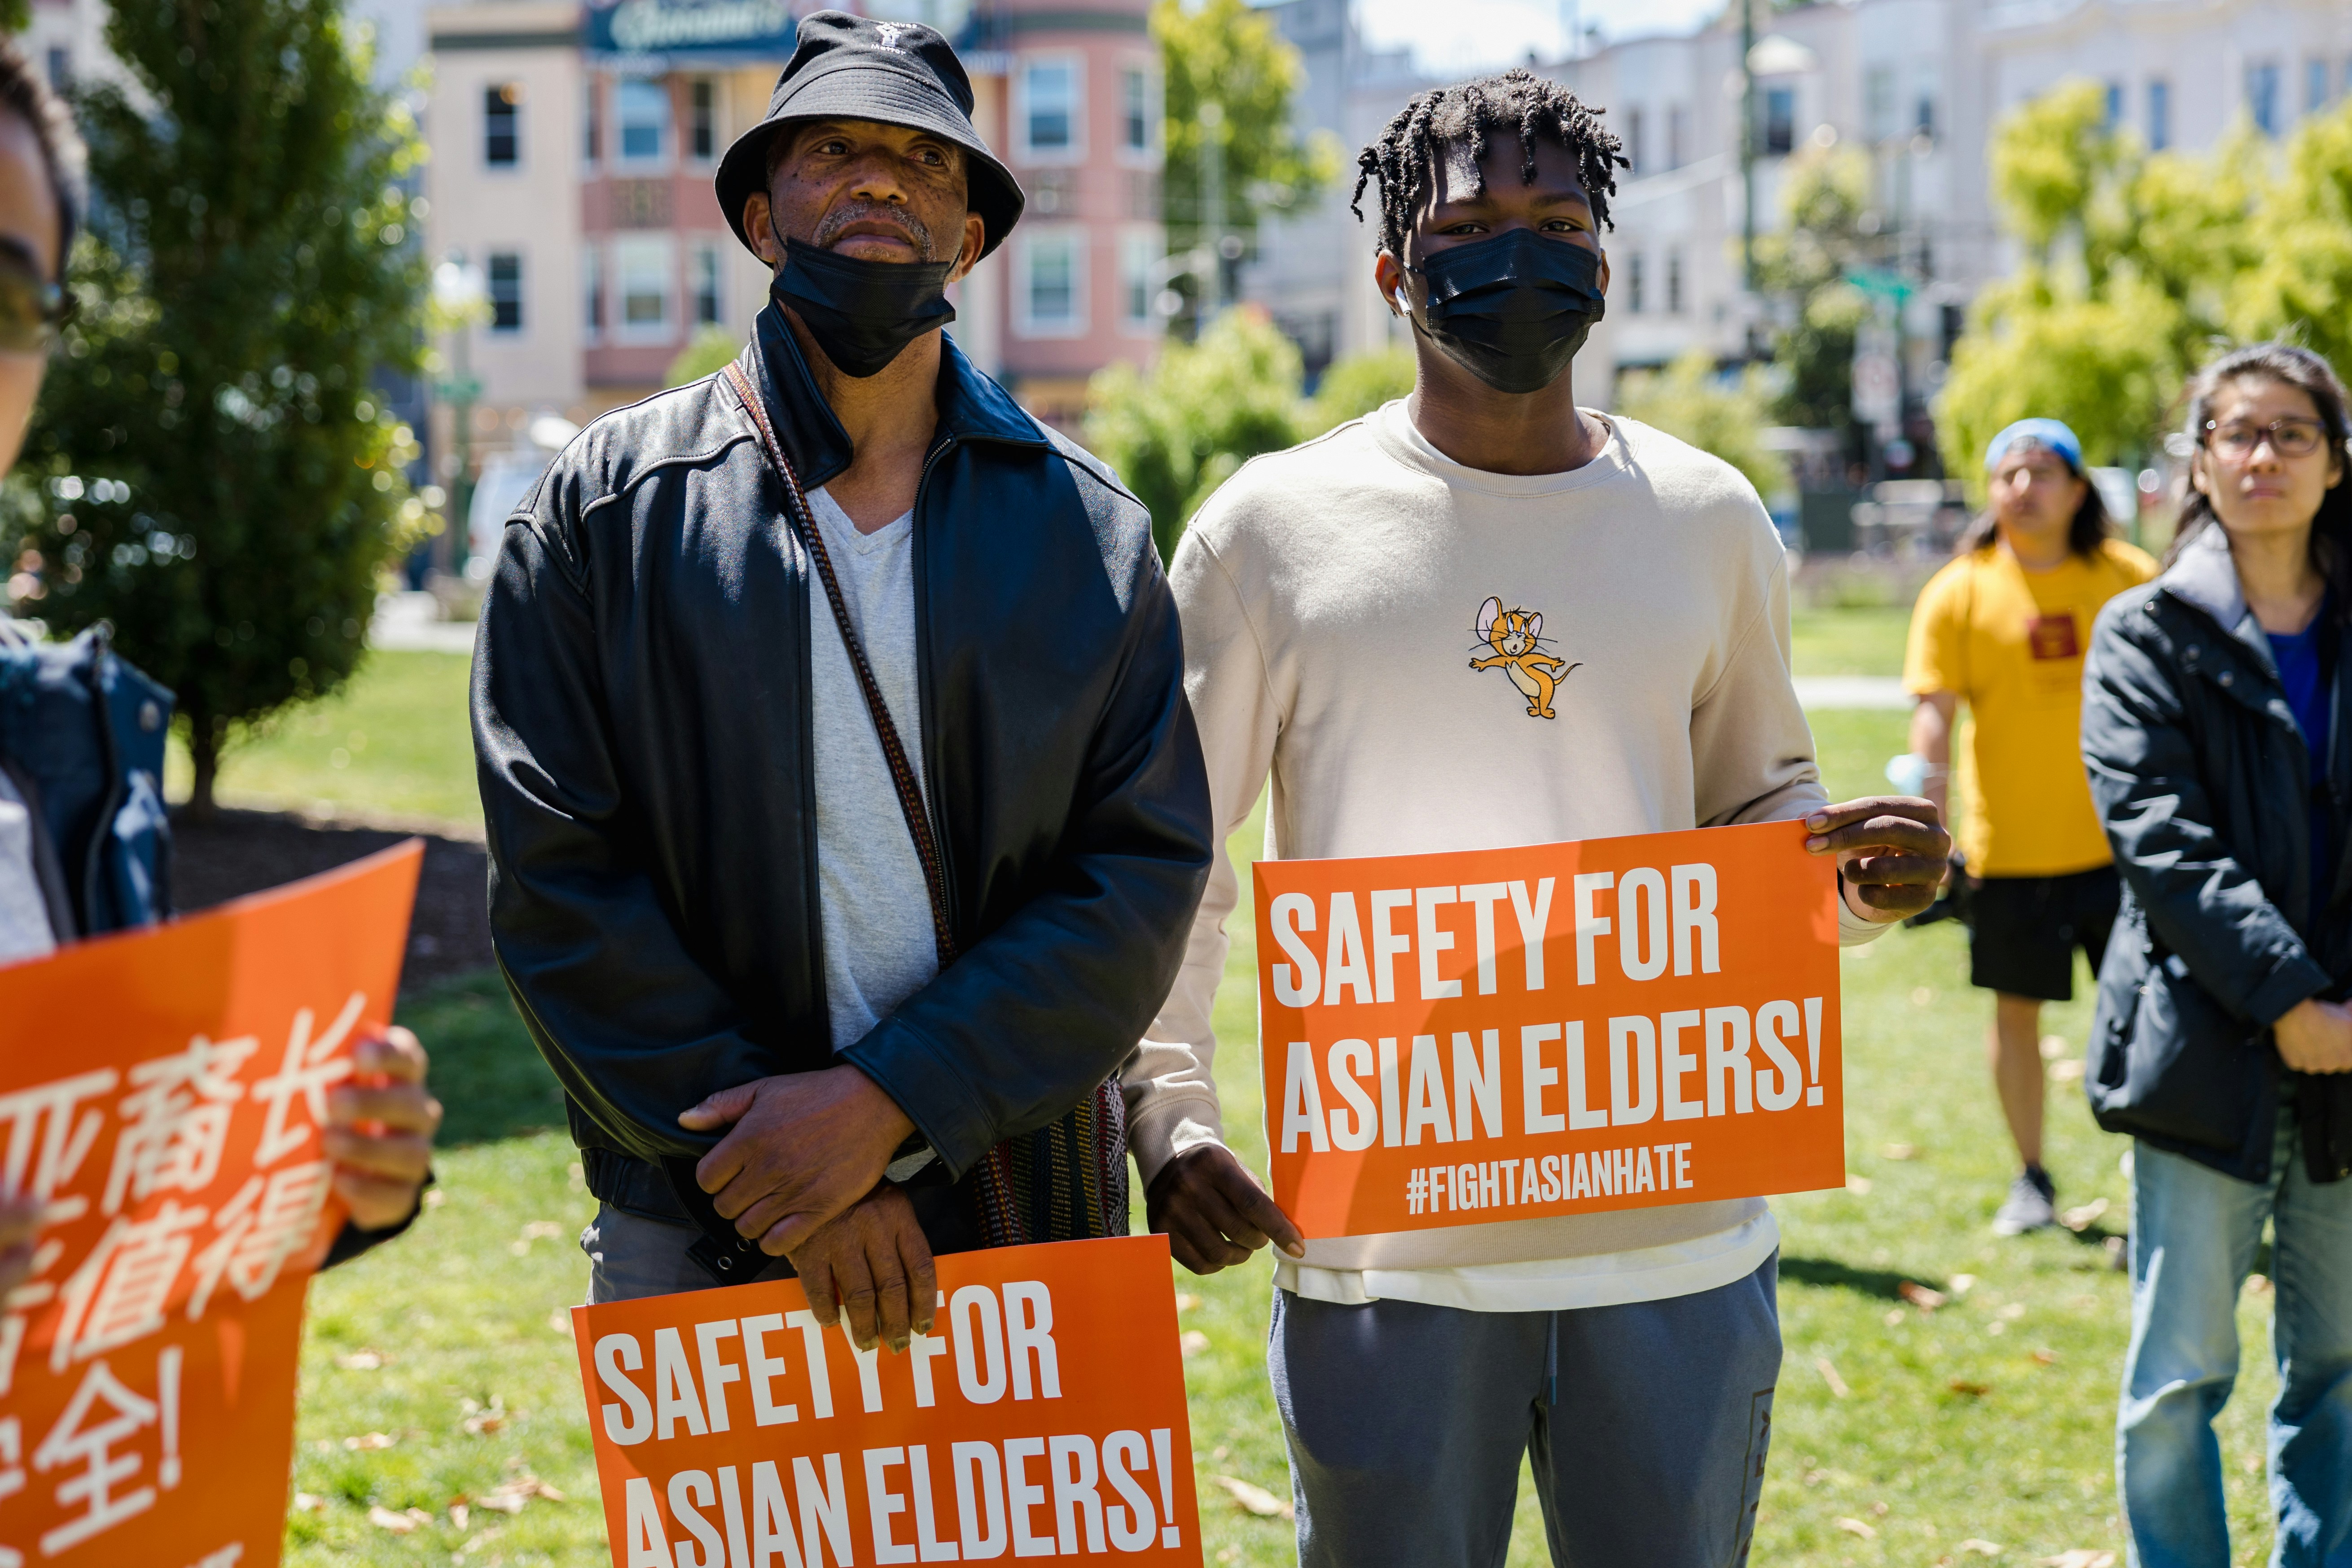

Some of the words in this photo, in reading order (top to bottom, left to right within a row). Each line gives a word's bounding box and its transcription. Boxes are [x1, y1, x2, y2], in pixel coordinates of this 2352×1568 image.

[871, 44, 906, 55] Matter
[1270, 877, 1556, 1008] SAFETY
[1574, 863, 1721, 986] FOR
[1281, 1028, 1503, 1153] ASIAN
[1521, 996, 1824, 1135] ELDERS!
[1406, 1142, 1694, 1215] #FIGHTASIANHATE
[0, 1160, 333, 1397] 值得
[594, 1307, 883, 1445] SAFETY
[908, 1281, 1062, 1408] FOR
[0, 1347, 182, 1557] 全!
[626, 1452, 854, 1568] ASIAN
[862, 1428, 1181, 1565] ELDERS!
